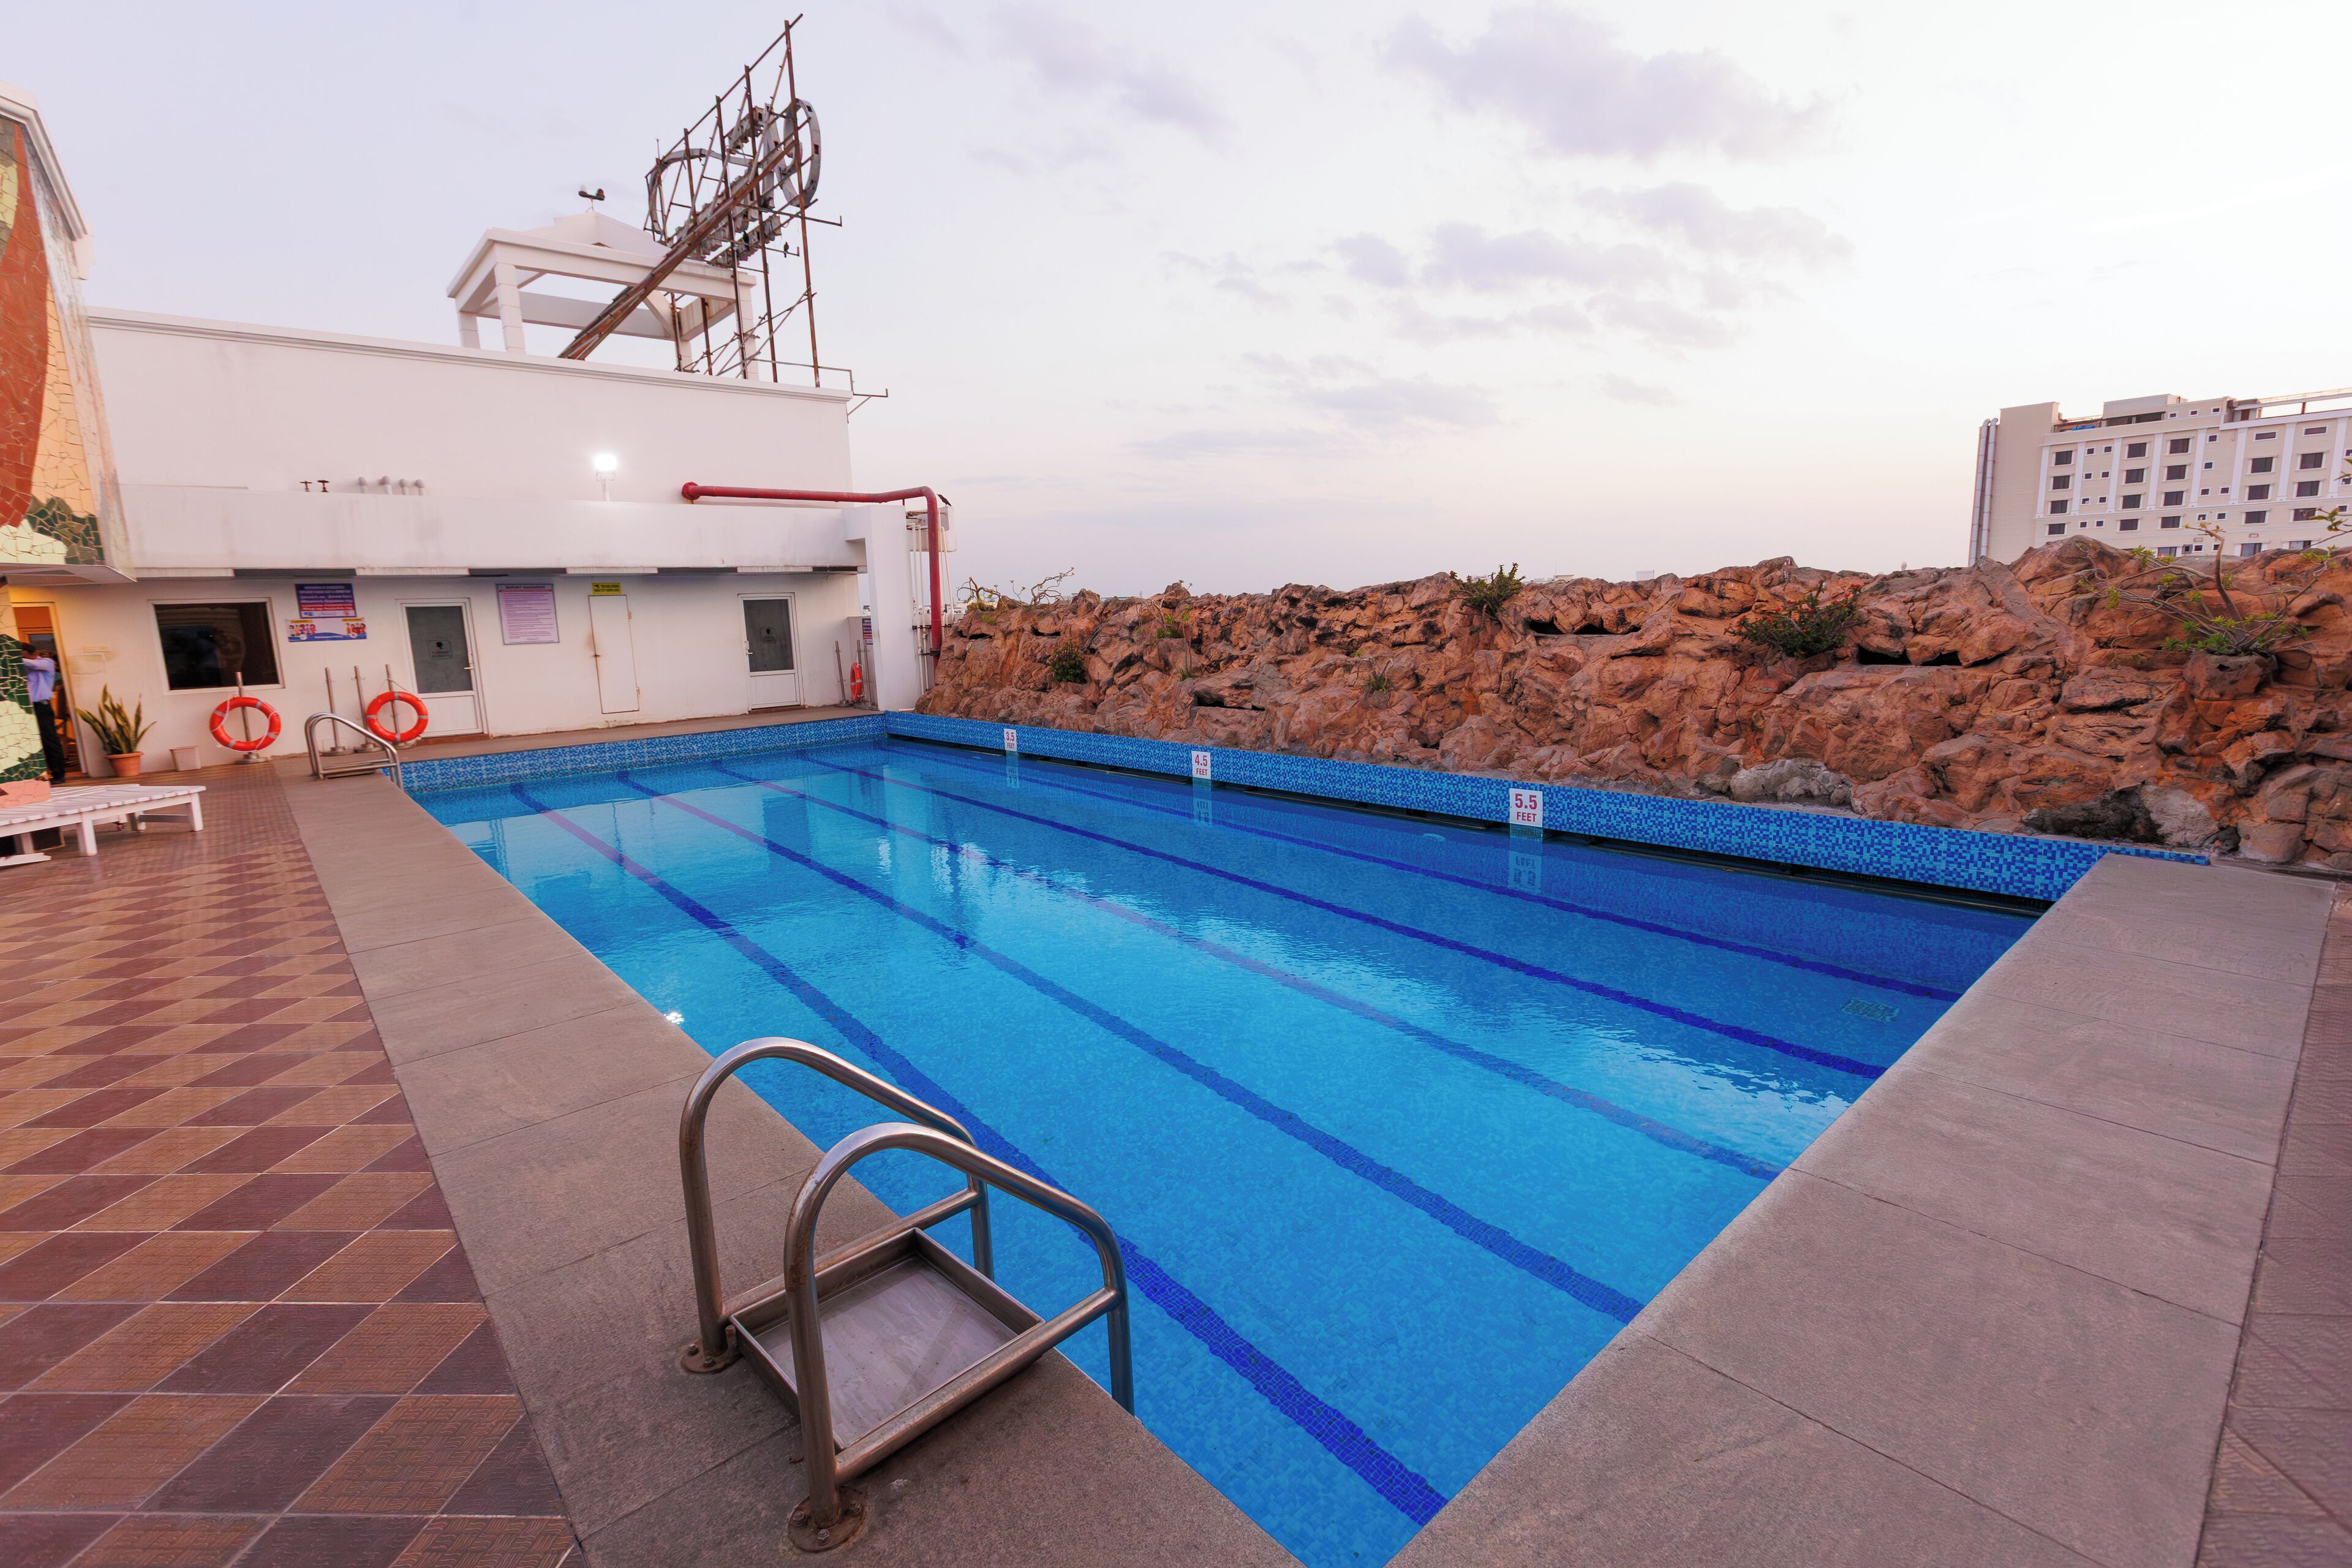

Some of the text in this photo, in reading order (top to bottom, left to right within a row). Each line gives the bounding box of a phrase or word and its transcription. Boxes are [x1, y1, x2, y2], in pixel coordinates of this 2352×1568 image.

[1006, 731, 1014, 741] 3.5
[1195, 754, 1207, 766] 4.5
[1515, 793, 1537, 810] 5.5
[1517, 812, 1537, 822] FEET
